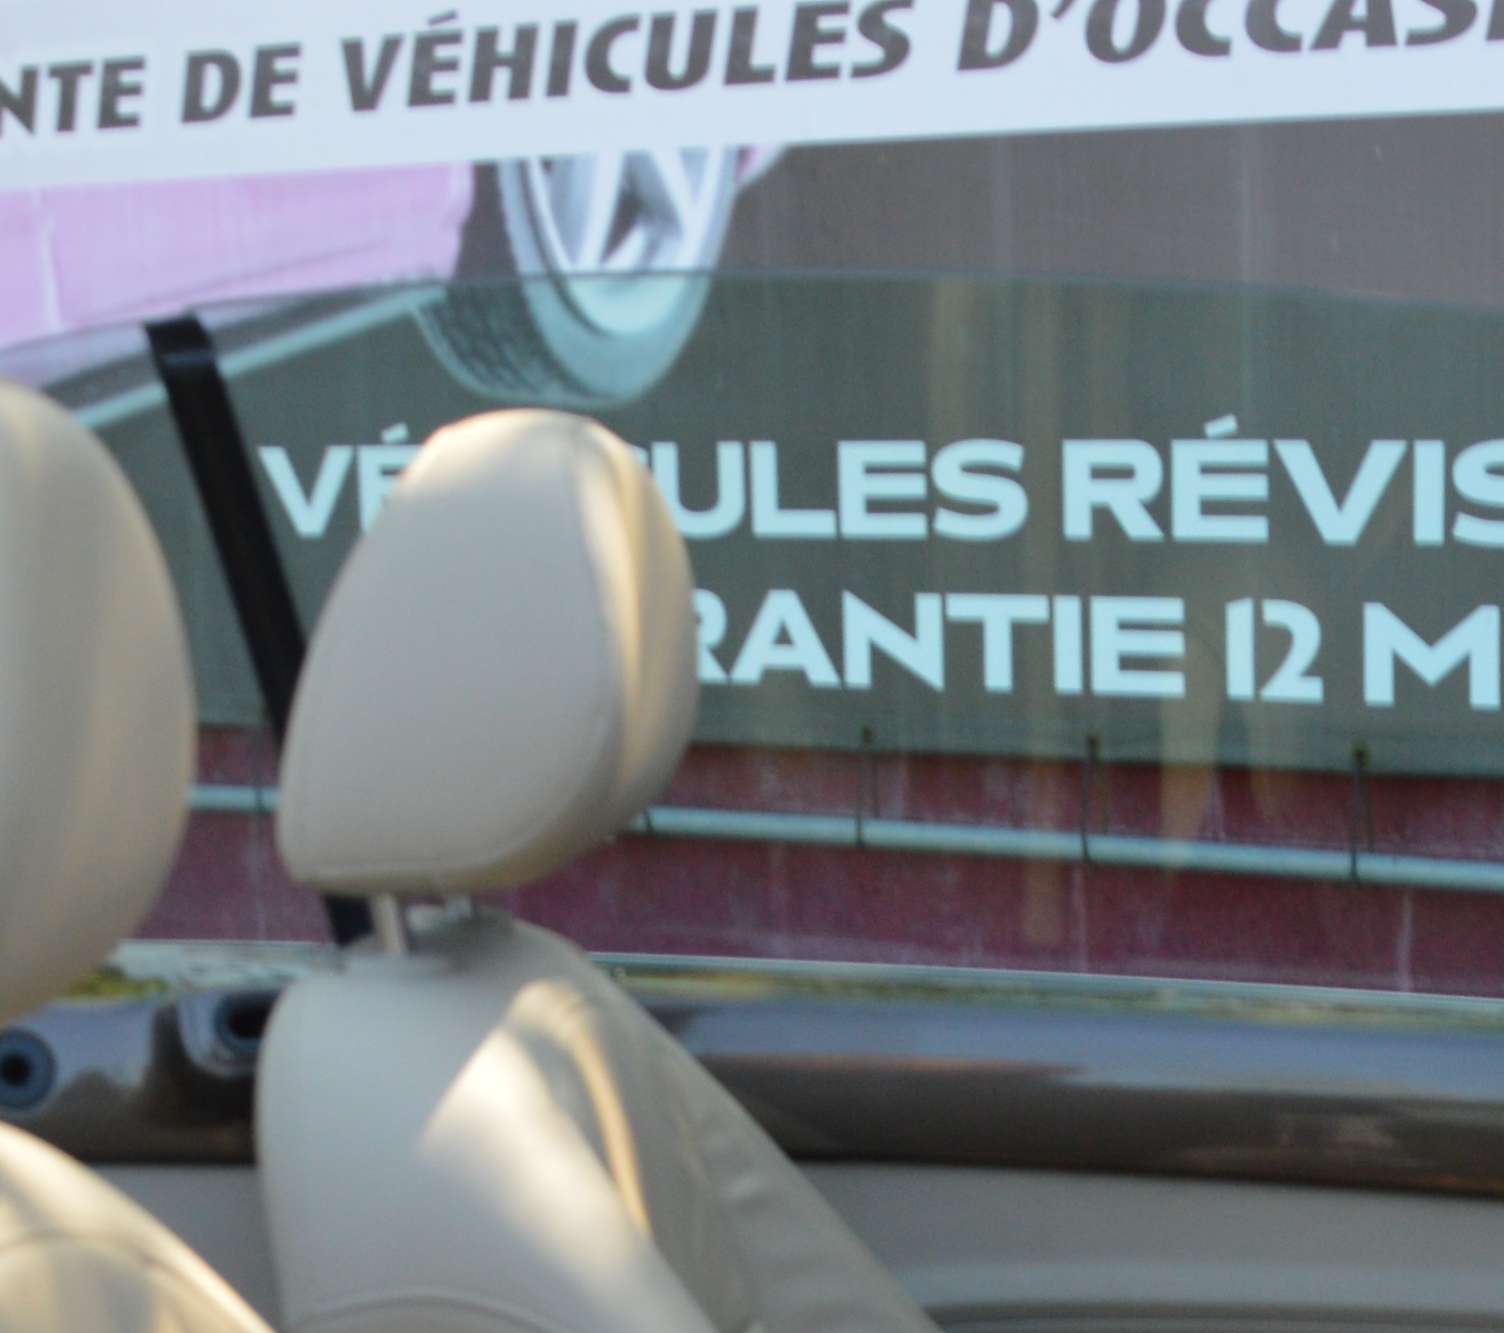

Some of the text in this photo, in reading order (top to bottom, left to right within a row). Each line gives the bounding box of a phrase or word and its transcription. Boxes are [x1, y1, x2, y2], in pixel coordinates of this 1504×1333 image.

[180, 44, 301, 124] DE
[341, 0, 915, 112] VÉHICULES
[258, 421, 1029, 542] VÉULES
[690, 586, 1187, 700] ANTIE
[1224, 597, 1325, 704] 12
